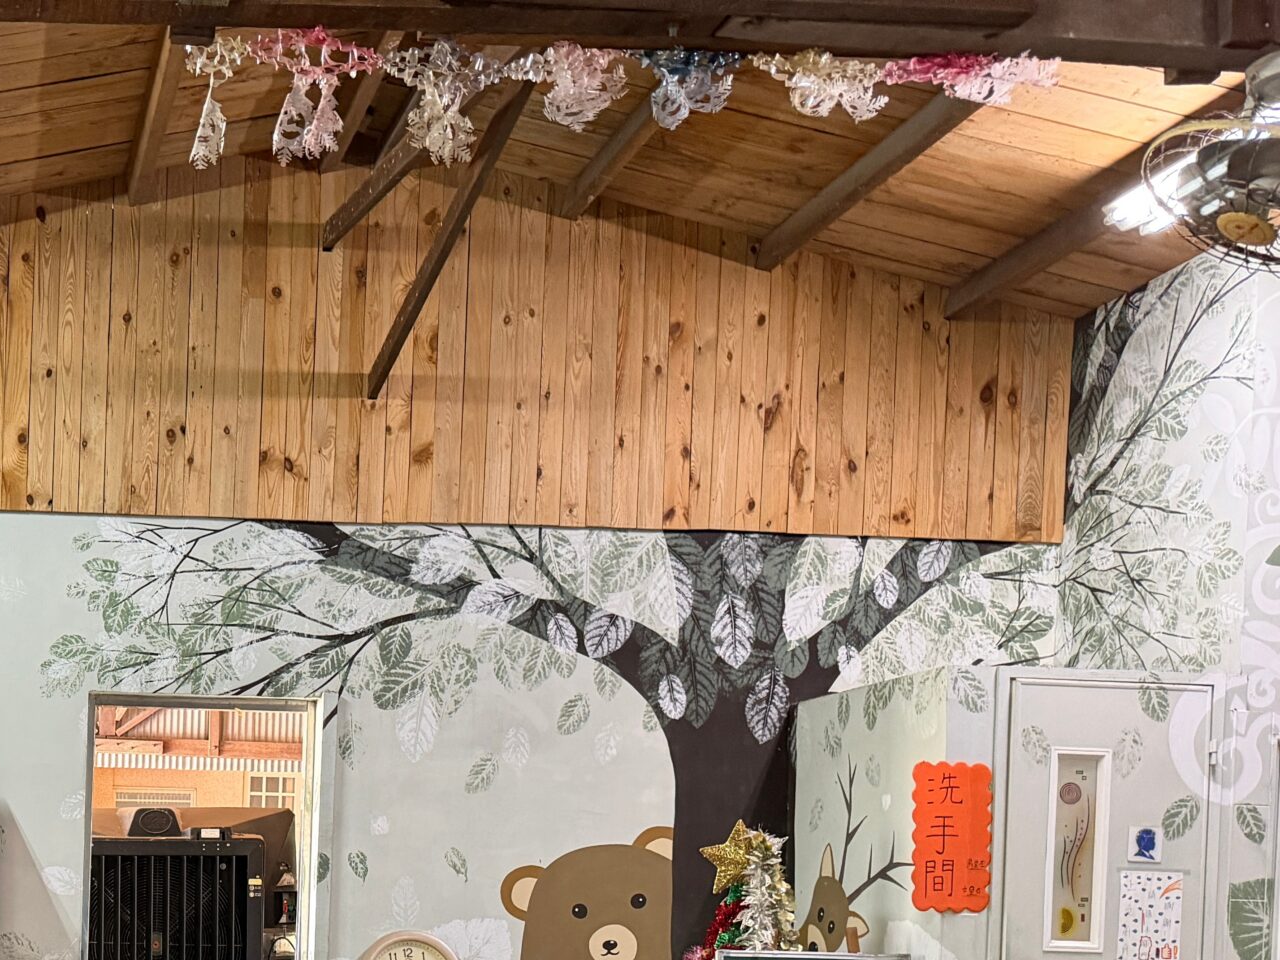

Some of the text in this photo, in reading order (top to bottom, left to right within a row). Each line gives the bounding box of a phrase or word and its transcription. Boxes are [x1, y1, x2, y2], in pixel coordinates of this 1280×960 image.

[925, 773, 963, 899] 洗手間
[402, 947, 413, 958] 12
